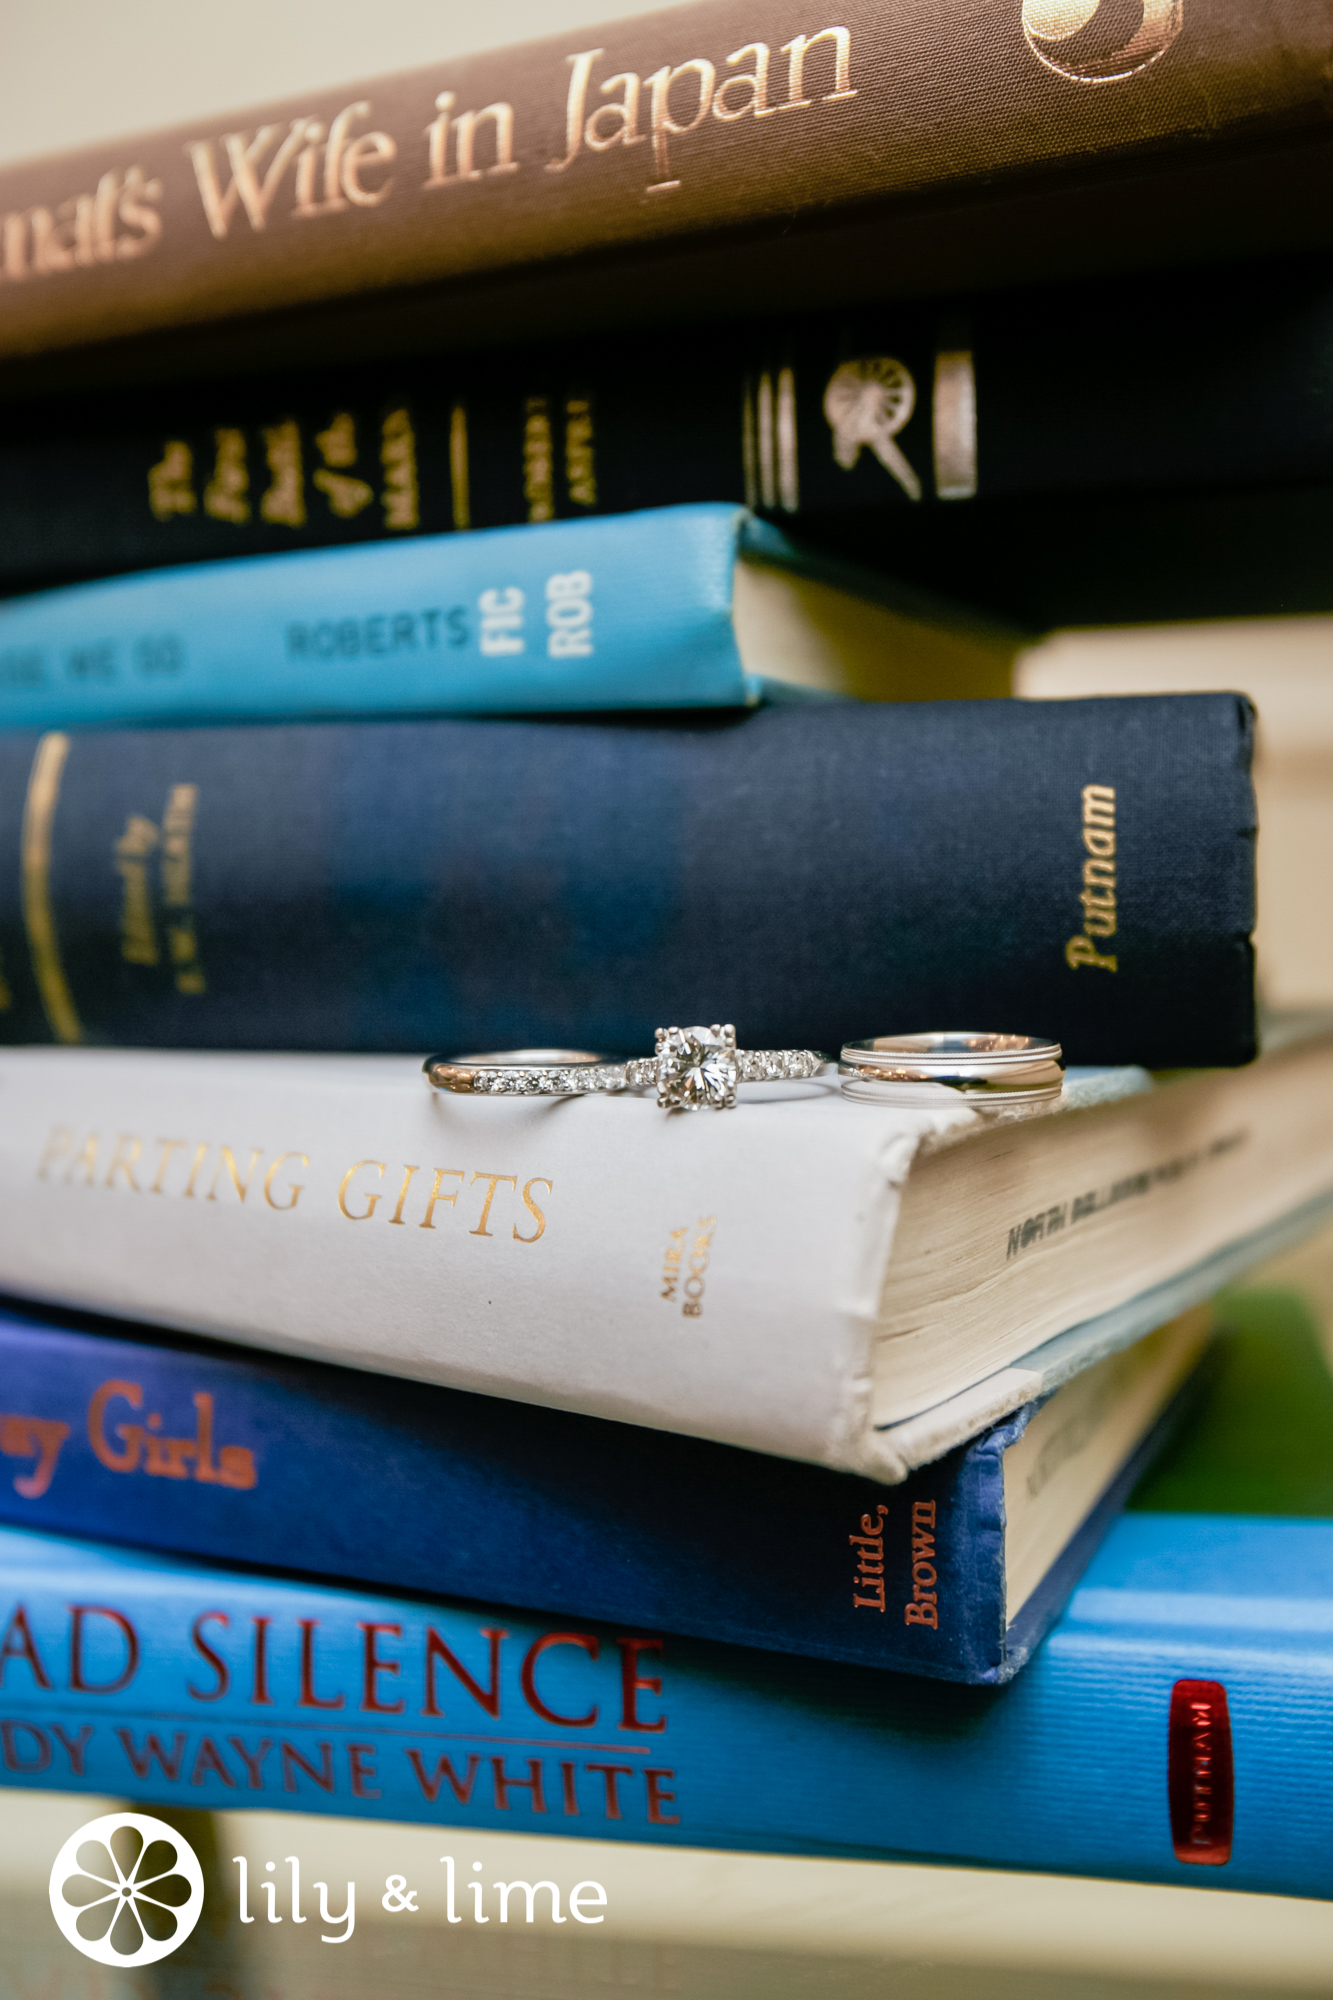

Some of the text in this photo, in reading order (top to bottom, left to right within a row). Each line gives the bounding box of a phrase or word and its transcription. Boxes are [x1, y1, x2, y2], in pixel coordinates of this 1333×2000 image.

[185, 100, 397, 239] Wife
[425, 91, 519, 190] in
[546, 25, 858, 193] Japan
[286, 607, 471, 664] ROBERTS
[479, 586, 525, 656] FIC
[546, 570, 594, 659] ROB
[1066, 784, 1117, 972] Putnam
[36, 1124, 554, 1244] PARTING GIFTS
[660, 1228, 688, 1303] MIRA
[682, 1216, 717, 1318] BOOKS
[87, 1379, 257, 1490] Girls
[849, 1504, 889, 1613] Little,
[904, 1499, 939, 1630] Brown
[187, 1611, 667, 1734] SILENCE
[116, 1727, 382, 1799] WAYNE
[405, 1748, 681, 1825] WHITE
